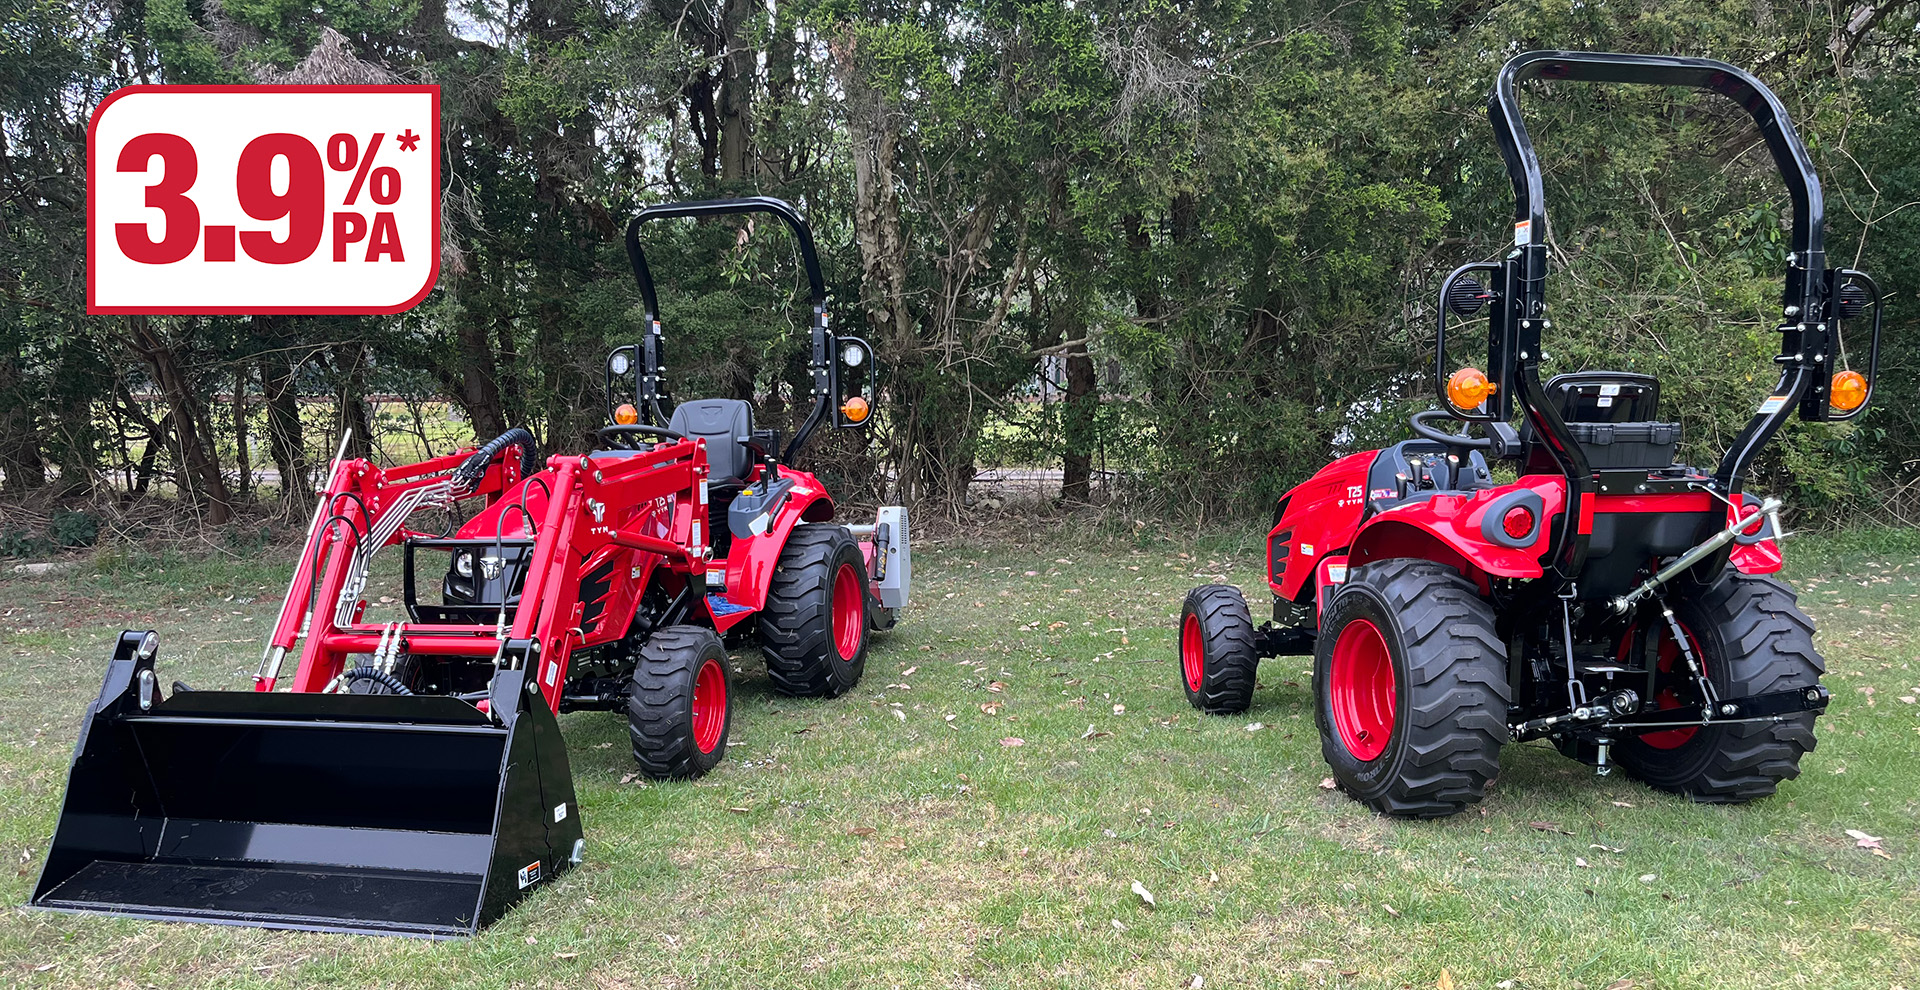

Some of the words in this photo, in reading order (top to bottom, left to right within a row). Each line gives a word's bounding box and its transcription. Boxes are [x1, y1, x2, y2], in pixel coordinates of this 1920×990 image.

[1346, 485, 1363, 499] T25
[1346, 498, 1363, 506] TYM
[591, 525, 609, 535] TYM
